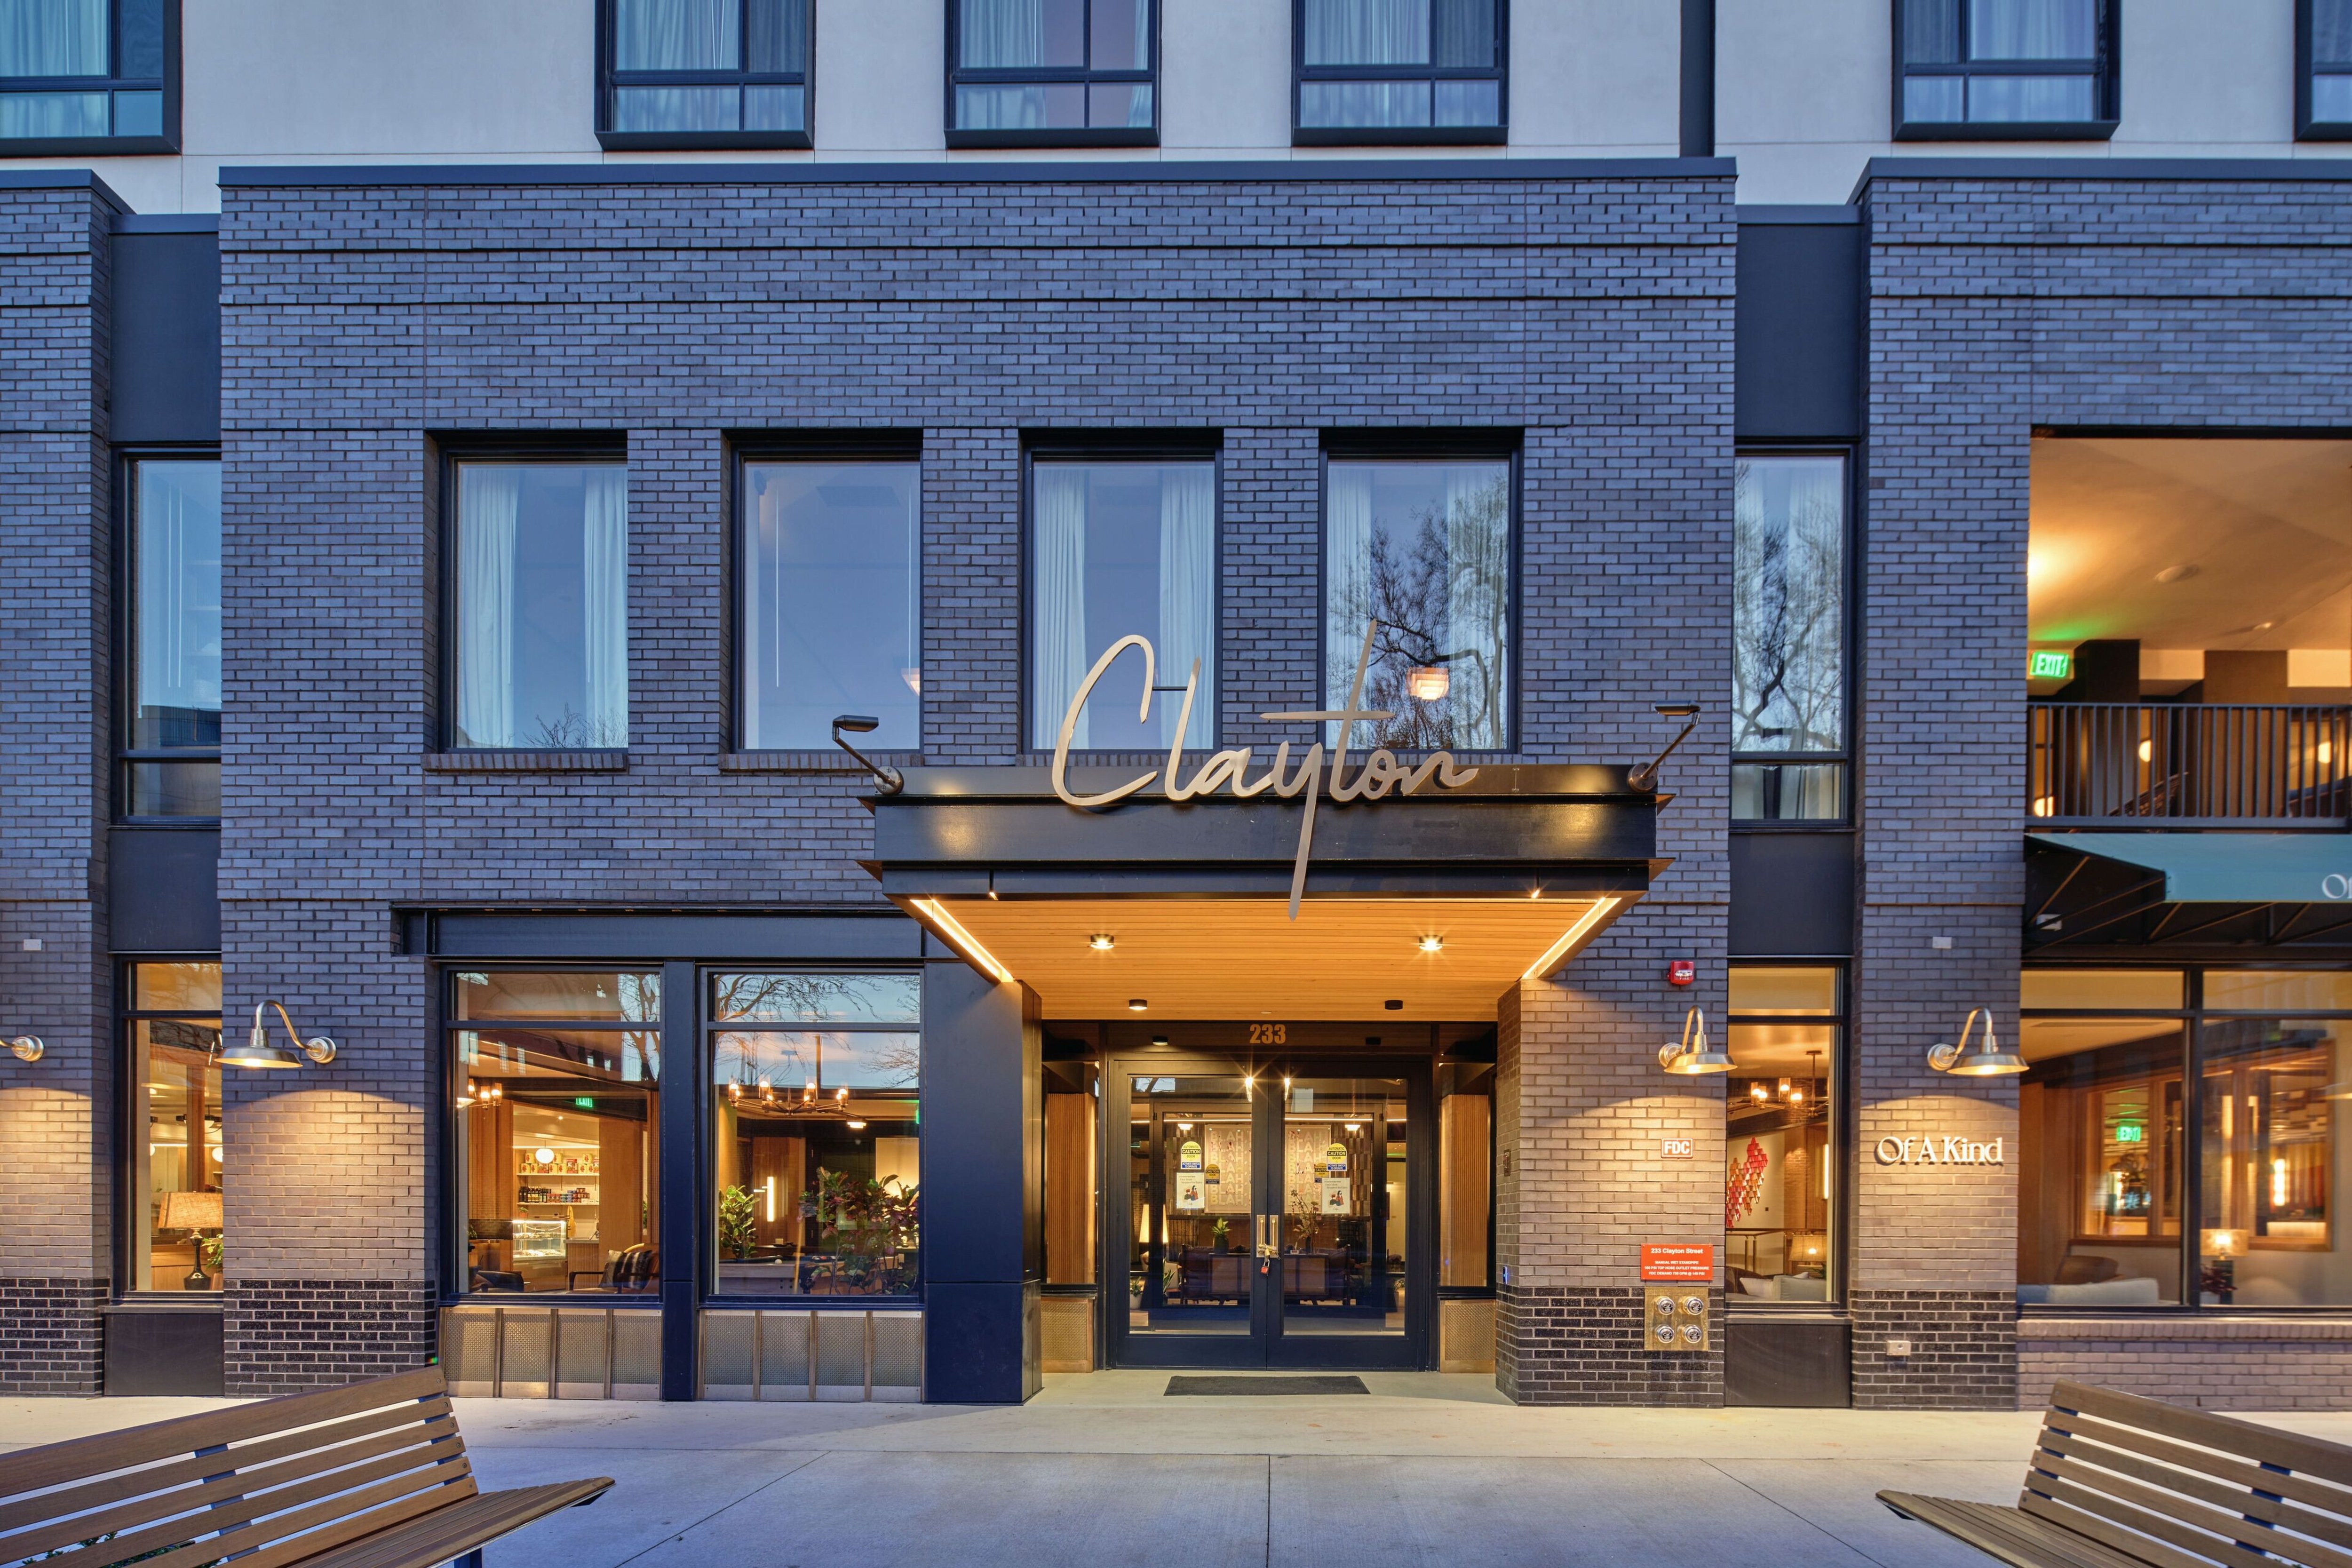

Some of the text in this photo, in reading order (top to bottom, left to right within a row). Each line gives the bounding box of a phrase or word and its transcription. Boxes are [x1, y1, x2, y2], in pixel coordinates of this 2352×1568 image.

[2036, 654, 2065, 676] EXIT
[1052, 619, 1478, 921] Clayton
[1249, 1023, 1286, 1044] 233
[1664, 1140, 1690, 1154] FDC
[1878, 1136, 2004, 1163] Of A Kind
